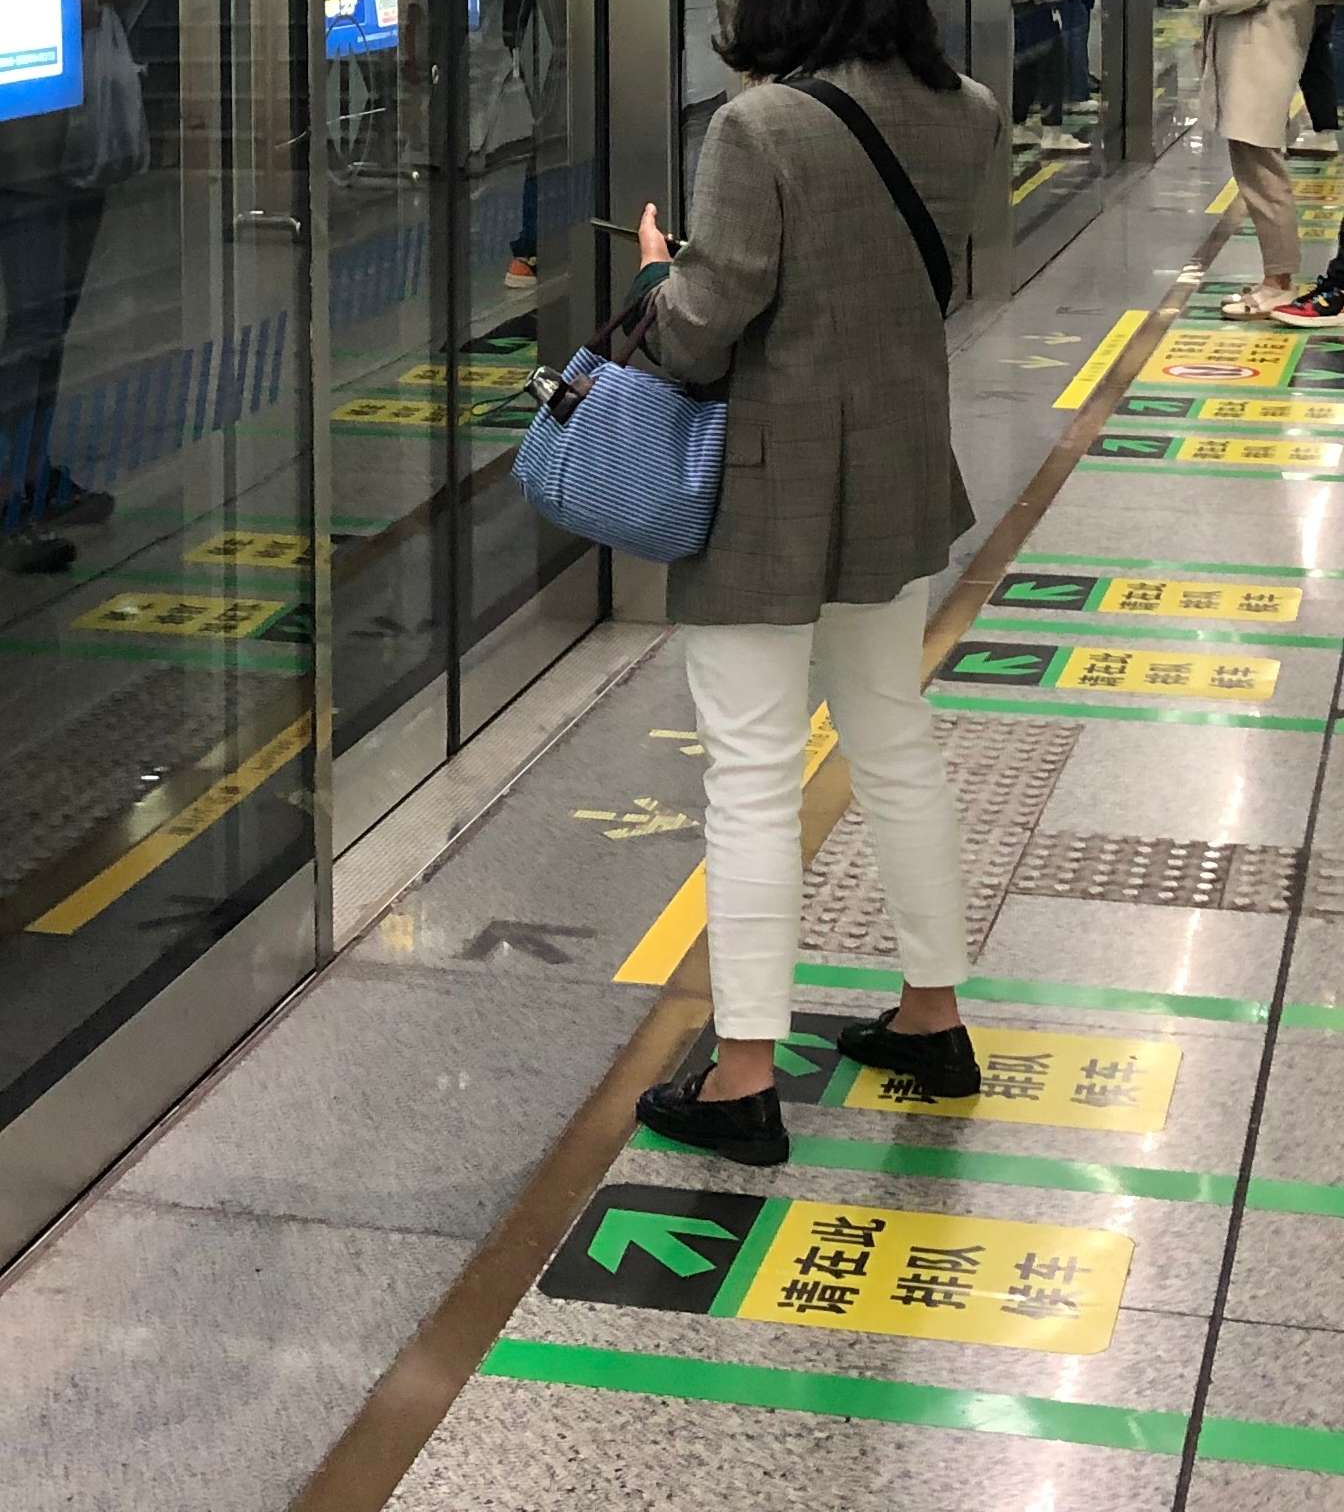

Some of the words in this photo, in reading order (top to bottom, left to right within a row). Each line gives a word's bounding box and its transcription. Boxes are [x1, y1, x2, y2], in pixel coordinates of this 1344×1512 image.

[979, 1052, 1054, 1102] 排队
[1069, 1054, 1142, 1108] 候车
[776, 1215, 887, 1316] 请在此
[889, 1244, 987, 1311] 排队
[999, 1251, 1094, 1321] 候车
